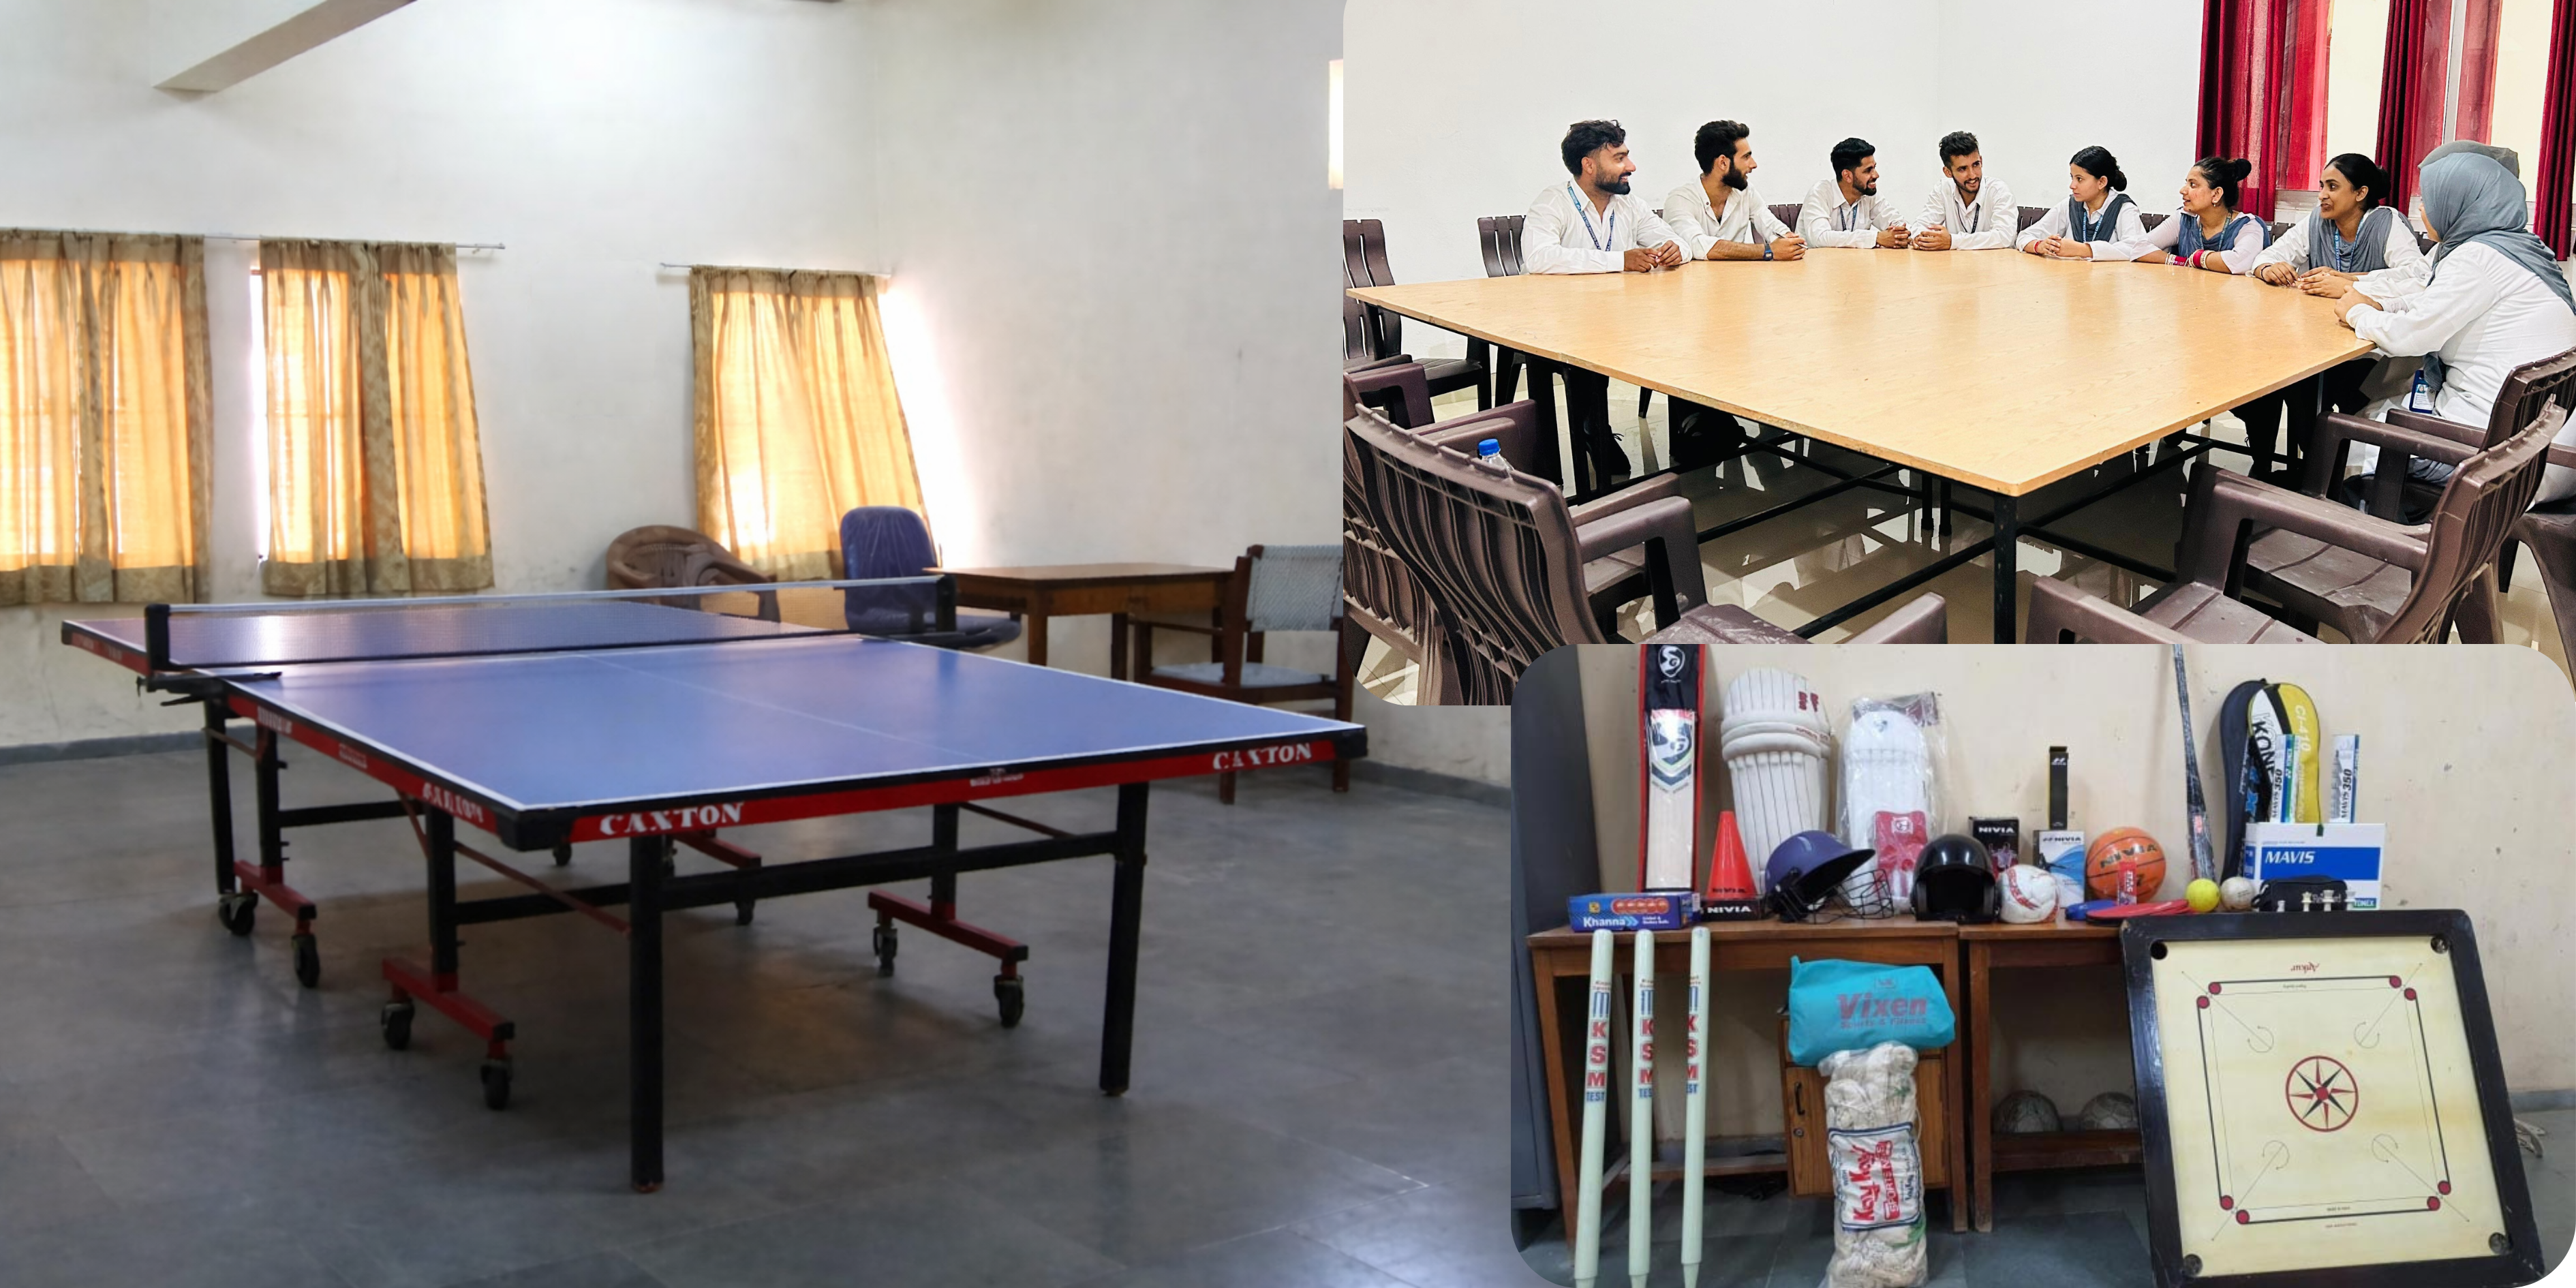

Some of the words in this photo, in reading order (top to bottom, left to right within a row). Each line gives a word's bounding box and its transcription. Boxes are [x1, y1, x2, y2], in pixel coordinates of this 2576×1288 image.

[1212, 743, 1312, 770] CAXTON
[2342, 769, 2352, 791] 350
[600, 802, 744, 835] CAXTON
[2265, 851, 2316, 864] MAVIS
[1583, 917, 1626, 927] Khanna
[1837, 992, 1927, 1020] Vixen
[1586, 1092, 1605, 1102] TEST
[1639, 1088, 1653, 1098] TES
